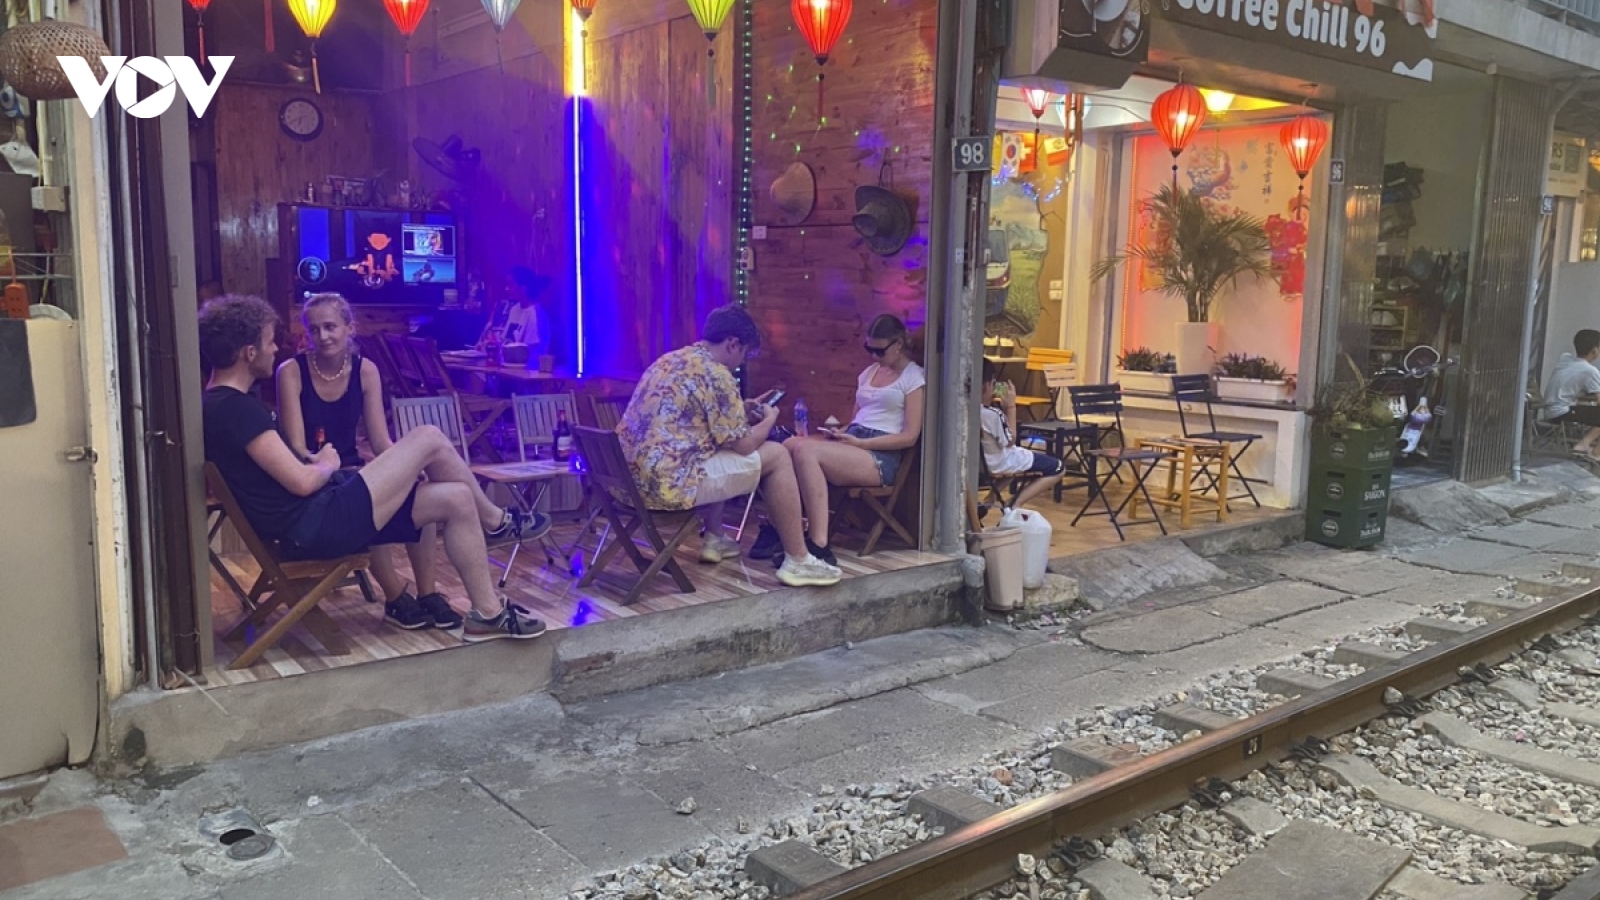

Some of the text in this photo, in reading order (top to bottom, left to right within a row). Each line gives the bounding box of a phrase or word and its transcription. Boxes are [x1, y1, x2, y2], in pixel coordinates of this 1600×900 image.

[1176, 0, 1386, 58] fee Chill 96
[960, 142, 984, 165] 98
